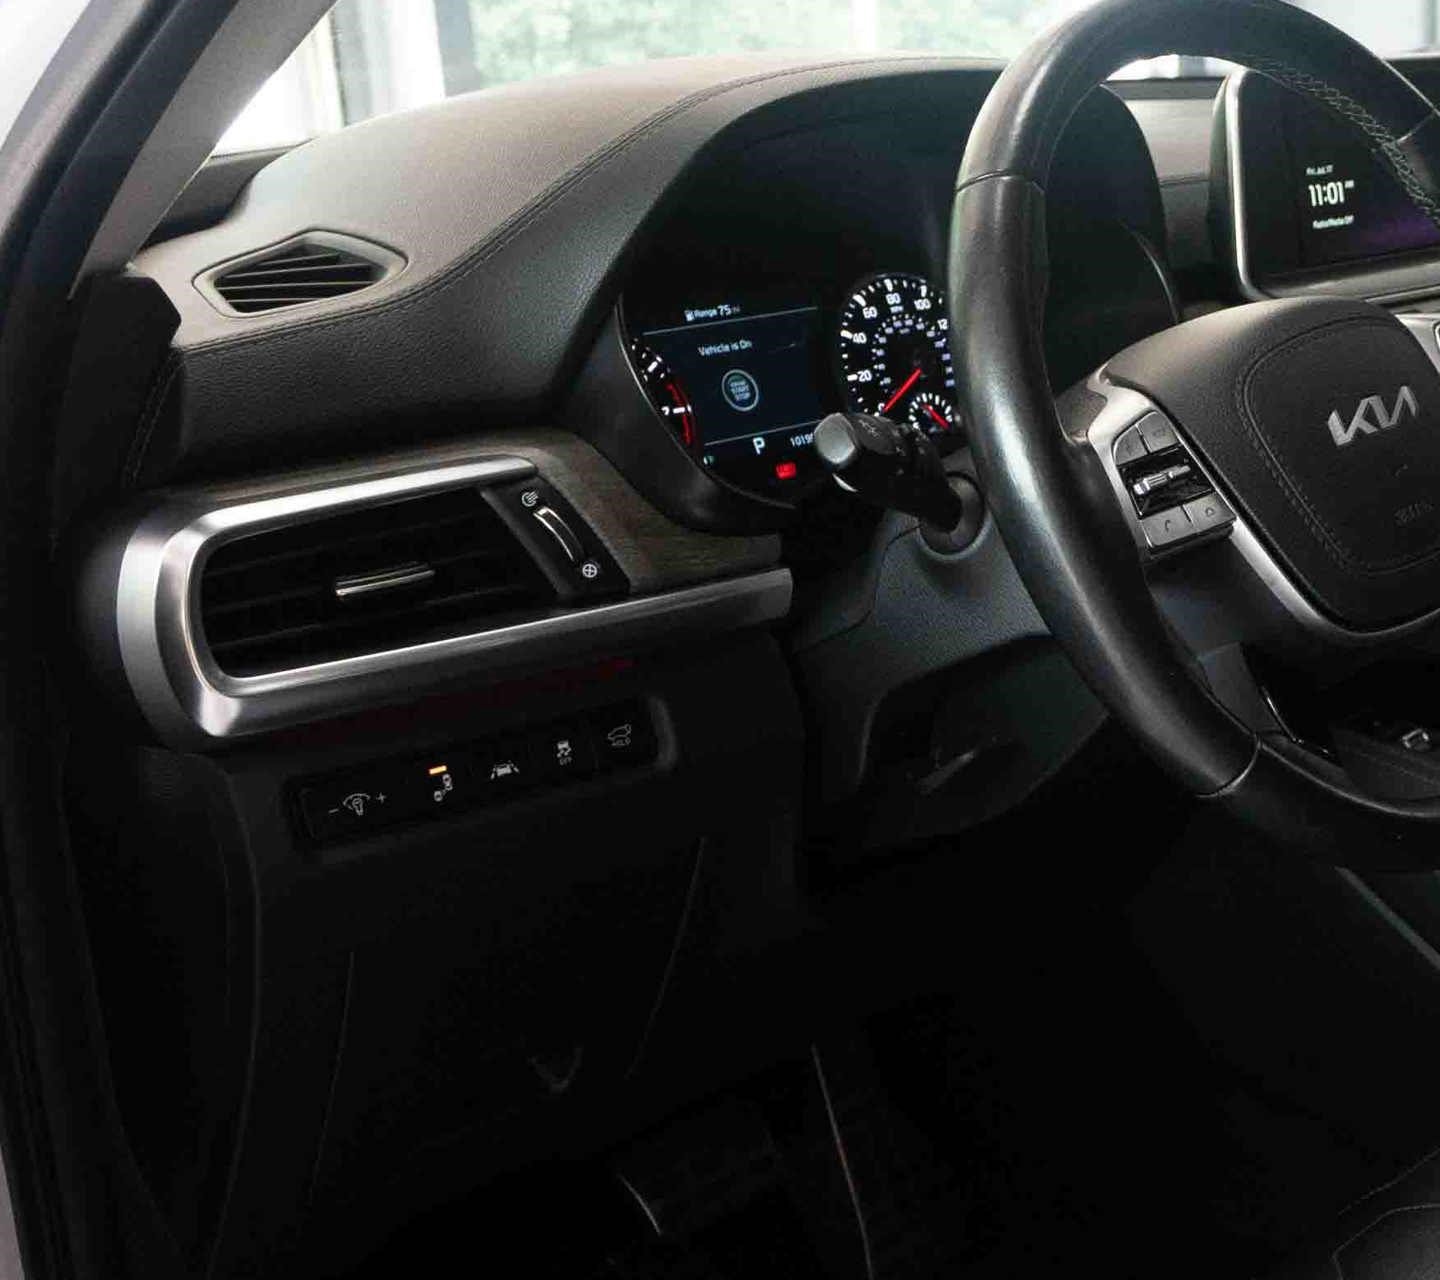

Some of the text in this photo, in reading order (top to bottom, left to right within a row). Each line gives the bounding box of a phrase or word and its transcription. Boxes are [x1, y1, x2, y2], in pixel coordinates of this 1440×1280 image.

[1307, 181, 1345, 207] 11:01
[717, 304, 732, 316] 75
[852, 332, 868, 345] 40
[858, 370, 873, 383] 20
[753, 436, 766, 455] P
